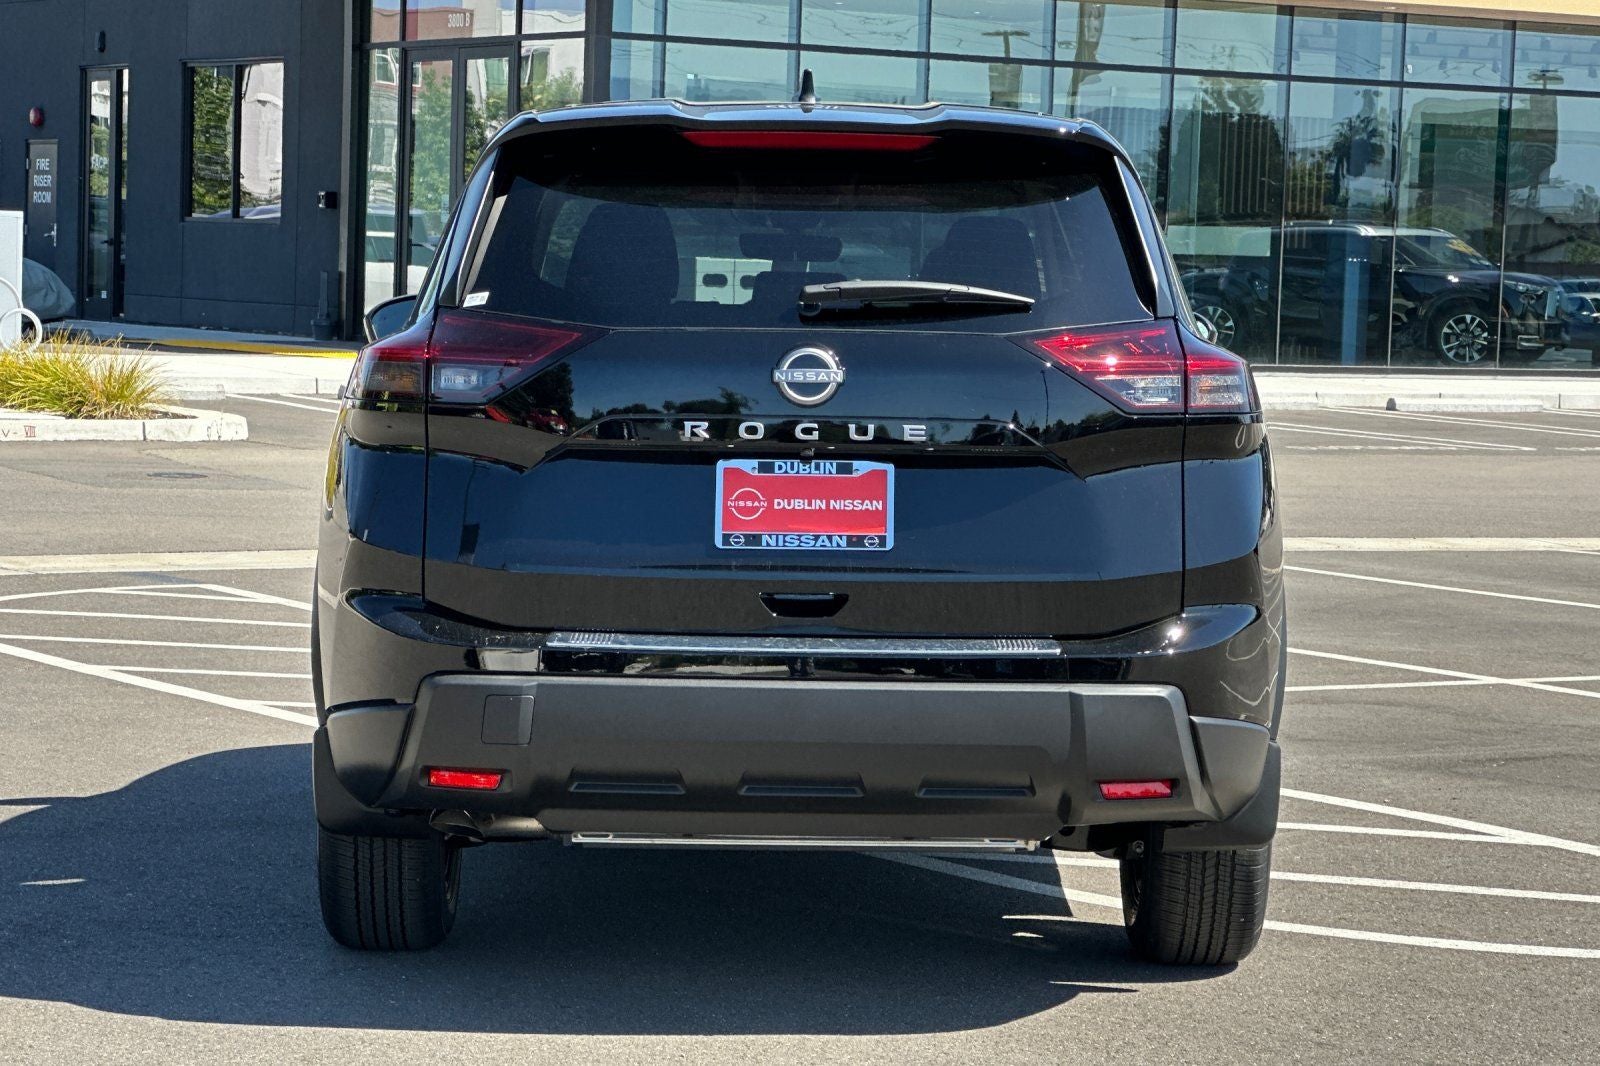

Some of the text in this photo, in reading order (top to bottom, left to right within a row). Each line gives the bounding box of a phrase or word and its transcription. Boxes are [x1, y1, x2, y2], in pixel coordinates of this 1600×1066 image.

[448, 13, 464, 27] 3800
[36, 159, 50, 170] FIRE
[33, 175, 52, 187] RISER
[33, 191, 51, 203] ROOM
[774, 370, 842, 382] NISSAN
[684, 421, 927, 442] ROGUE
[774, 461, 837, 475] DUBLIN
[727, 500, 768, 508] NISSAN
[773, 498, 883, 511] DUBLIN NISSAN
[761, 534, 847, 547] NISSAN
